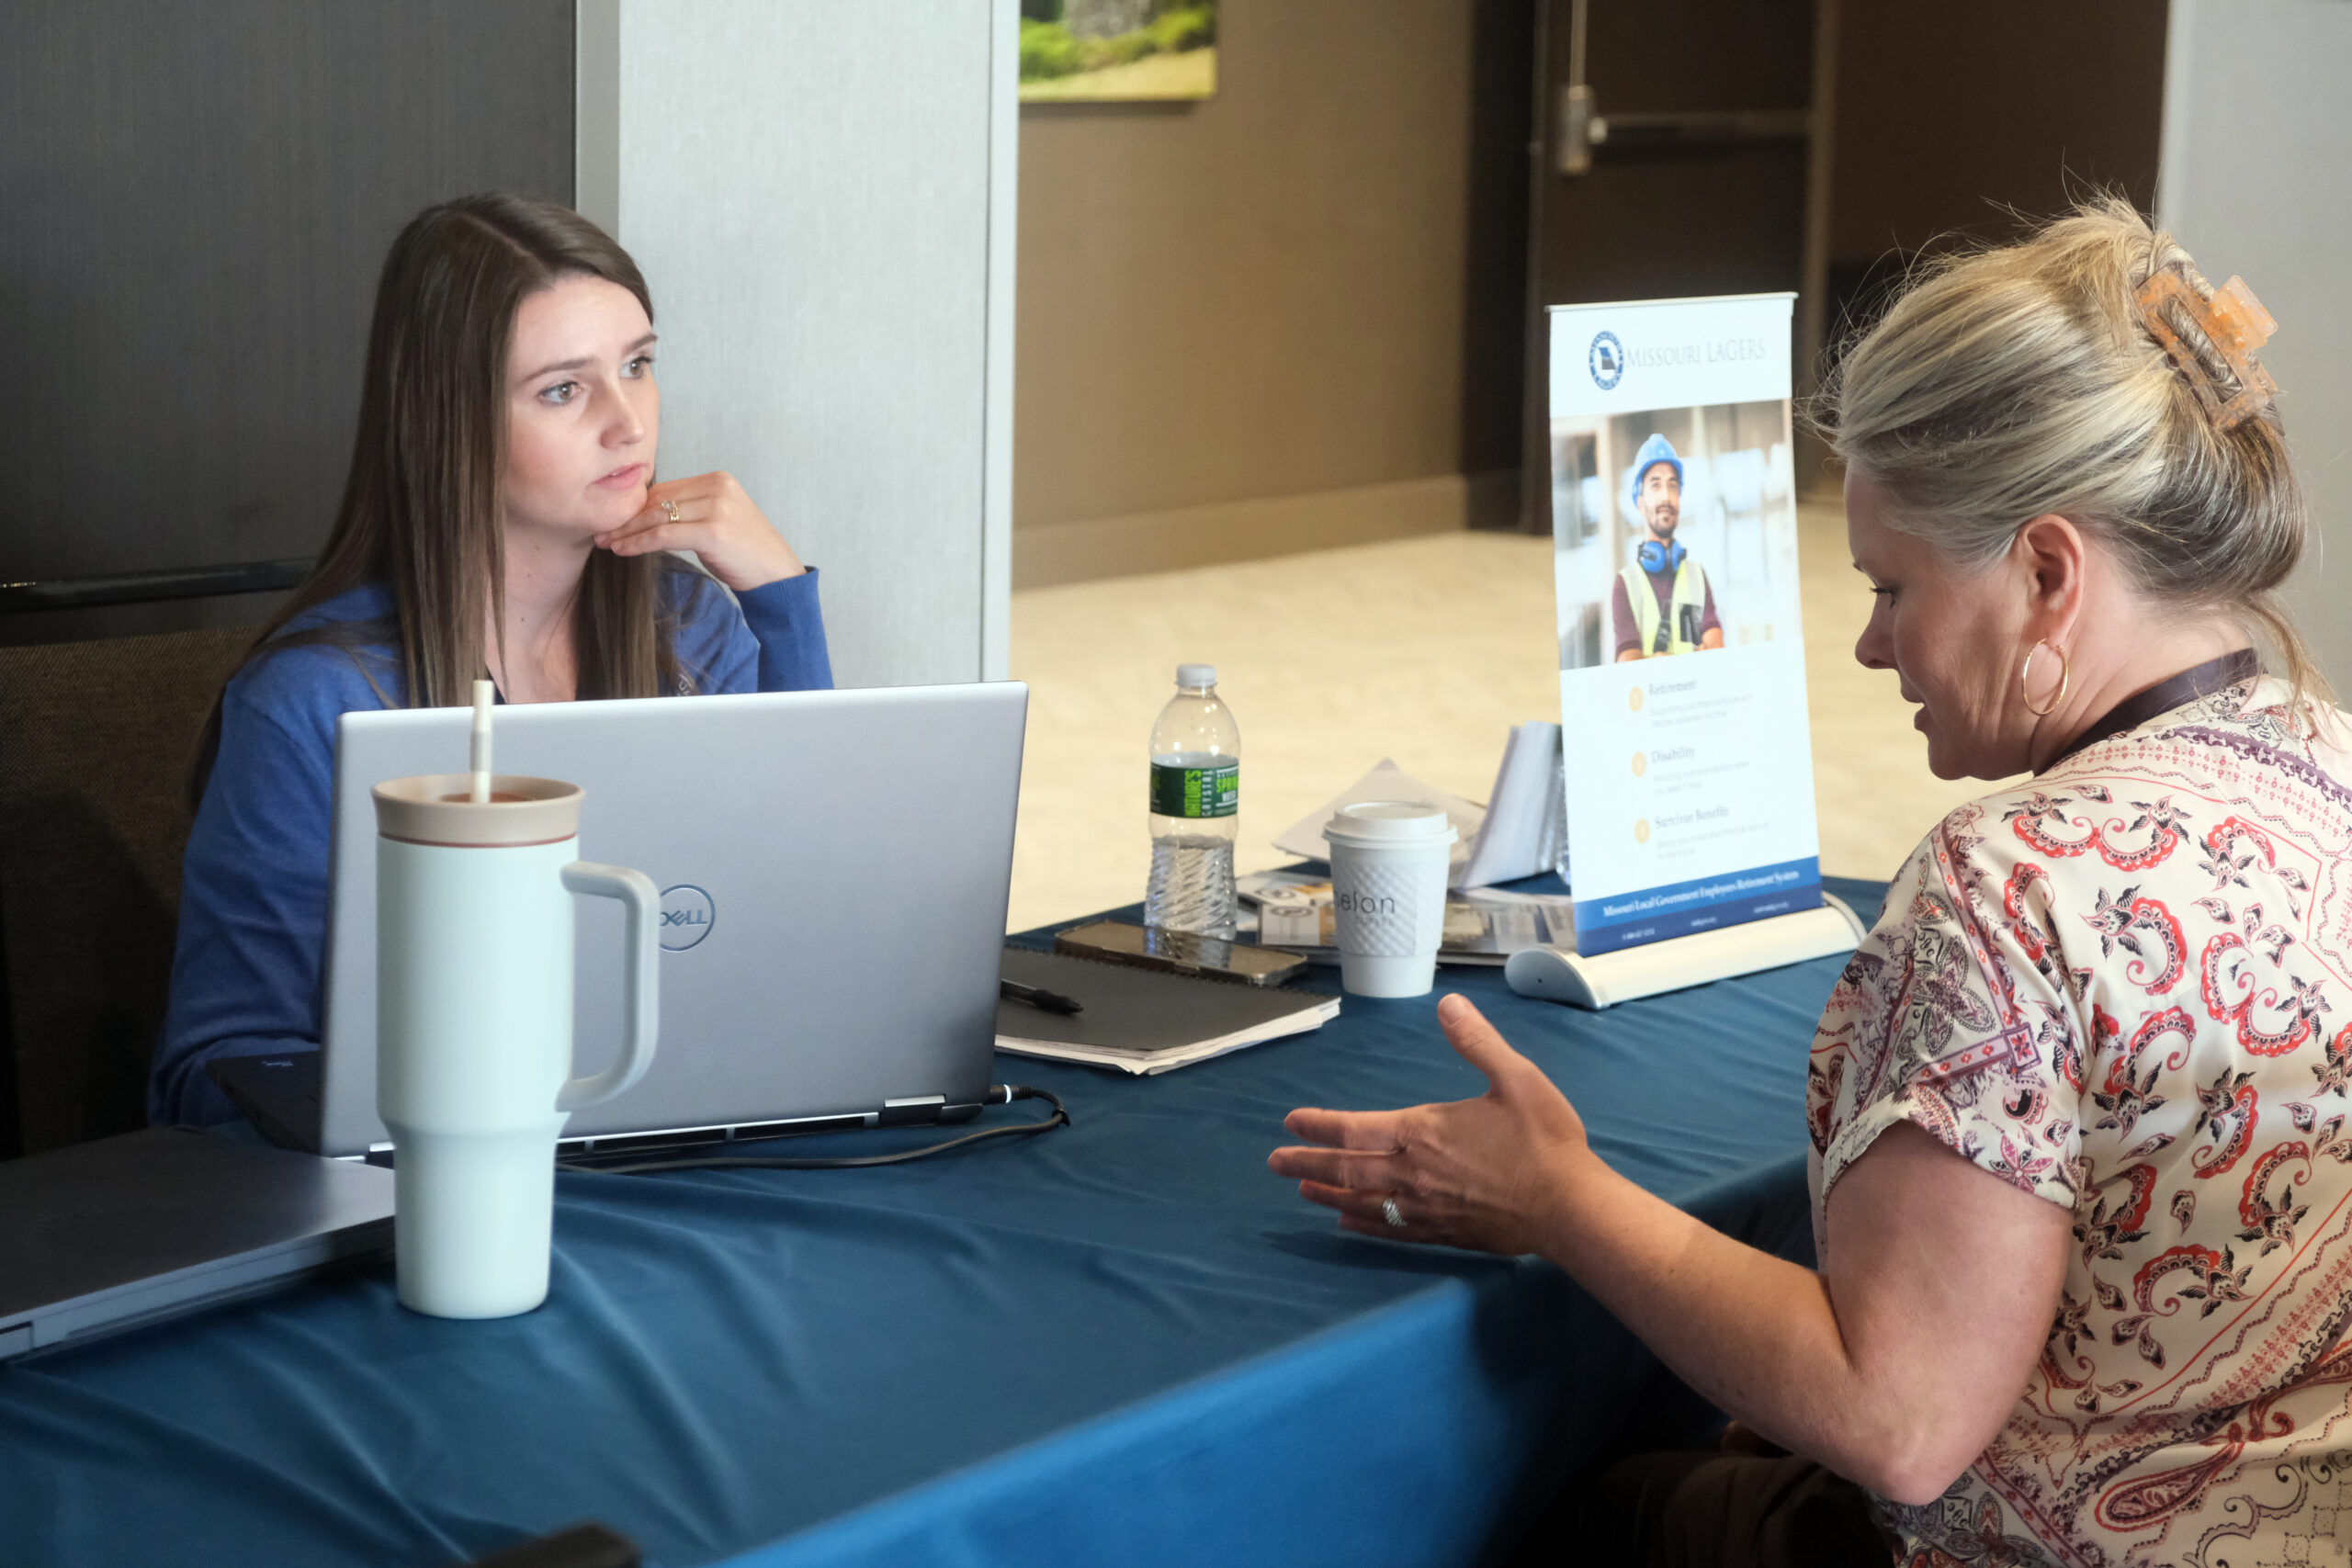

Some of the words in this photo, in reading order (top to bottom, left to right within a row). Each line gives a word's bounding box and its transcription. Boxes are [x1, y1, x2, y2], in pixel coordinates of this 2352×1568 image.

[1626, 344, 1702, 367] MISSOURI
[1706, 337, 1766, 362] LAGERS
[1648, 679, 1698, 696] Retirement
[1651, 746, 1696, 764] Disability
[1655, 812, 1694, 829] Survivor
[1696, 806, 1730, 823] Benefits
[1603, 903, 1634, 918] Missouri
[1634, 896, 1656, 911] Local
[1657, 891, 1699, 907] Government
[1700, 883, 1736, 899] Employees
[1736, 875, 1773, 891] Retirement
[1773, 871, 1801, 886] System
[660, 908, 707, 927] DELL
